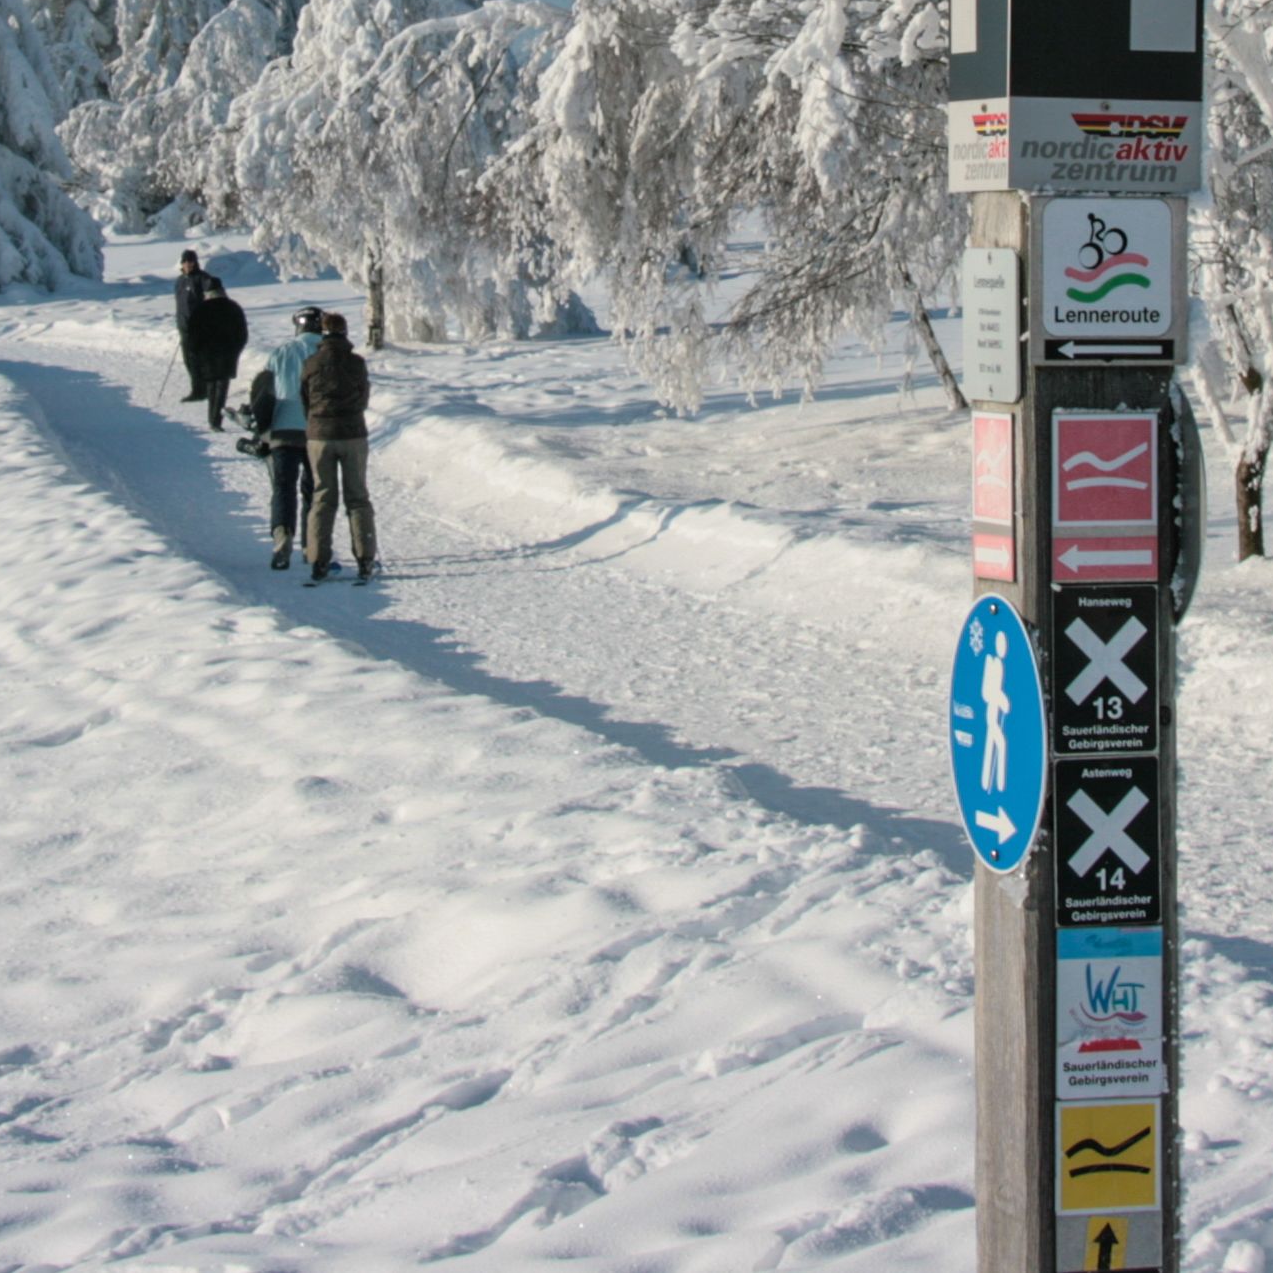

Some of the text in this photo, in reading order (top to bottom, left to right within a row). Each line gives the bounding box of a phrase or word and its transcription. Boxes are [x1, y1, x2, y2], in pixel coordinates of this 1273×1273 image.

[1051, 161, 1177, 182] zentrum
[1054, 305, 1160, 324] Lenneroute
[1078, 596, 1132, 608] Hanseweg
[1093, 696, 1123, 719] 13
[1062, 724, 1149, 737] Sauerländischer
[1068, 737, 1143, 750] Gebirgsverein
[1081, 767, 1133, 780] Astenweg
[1096, 868, 1126, 891] 14
[1065, 894, 1151, 908] Sauerländischer
[1071, 908, 1146, 922] Gebirgsverein
[1063, 1058, 1158, 1073] Sauerländischer
[1069, 1073, 1149, 1087] Gebirgsverein
